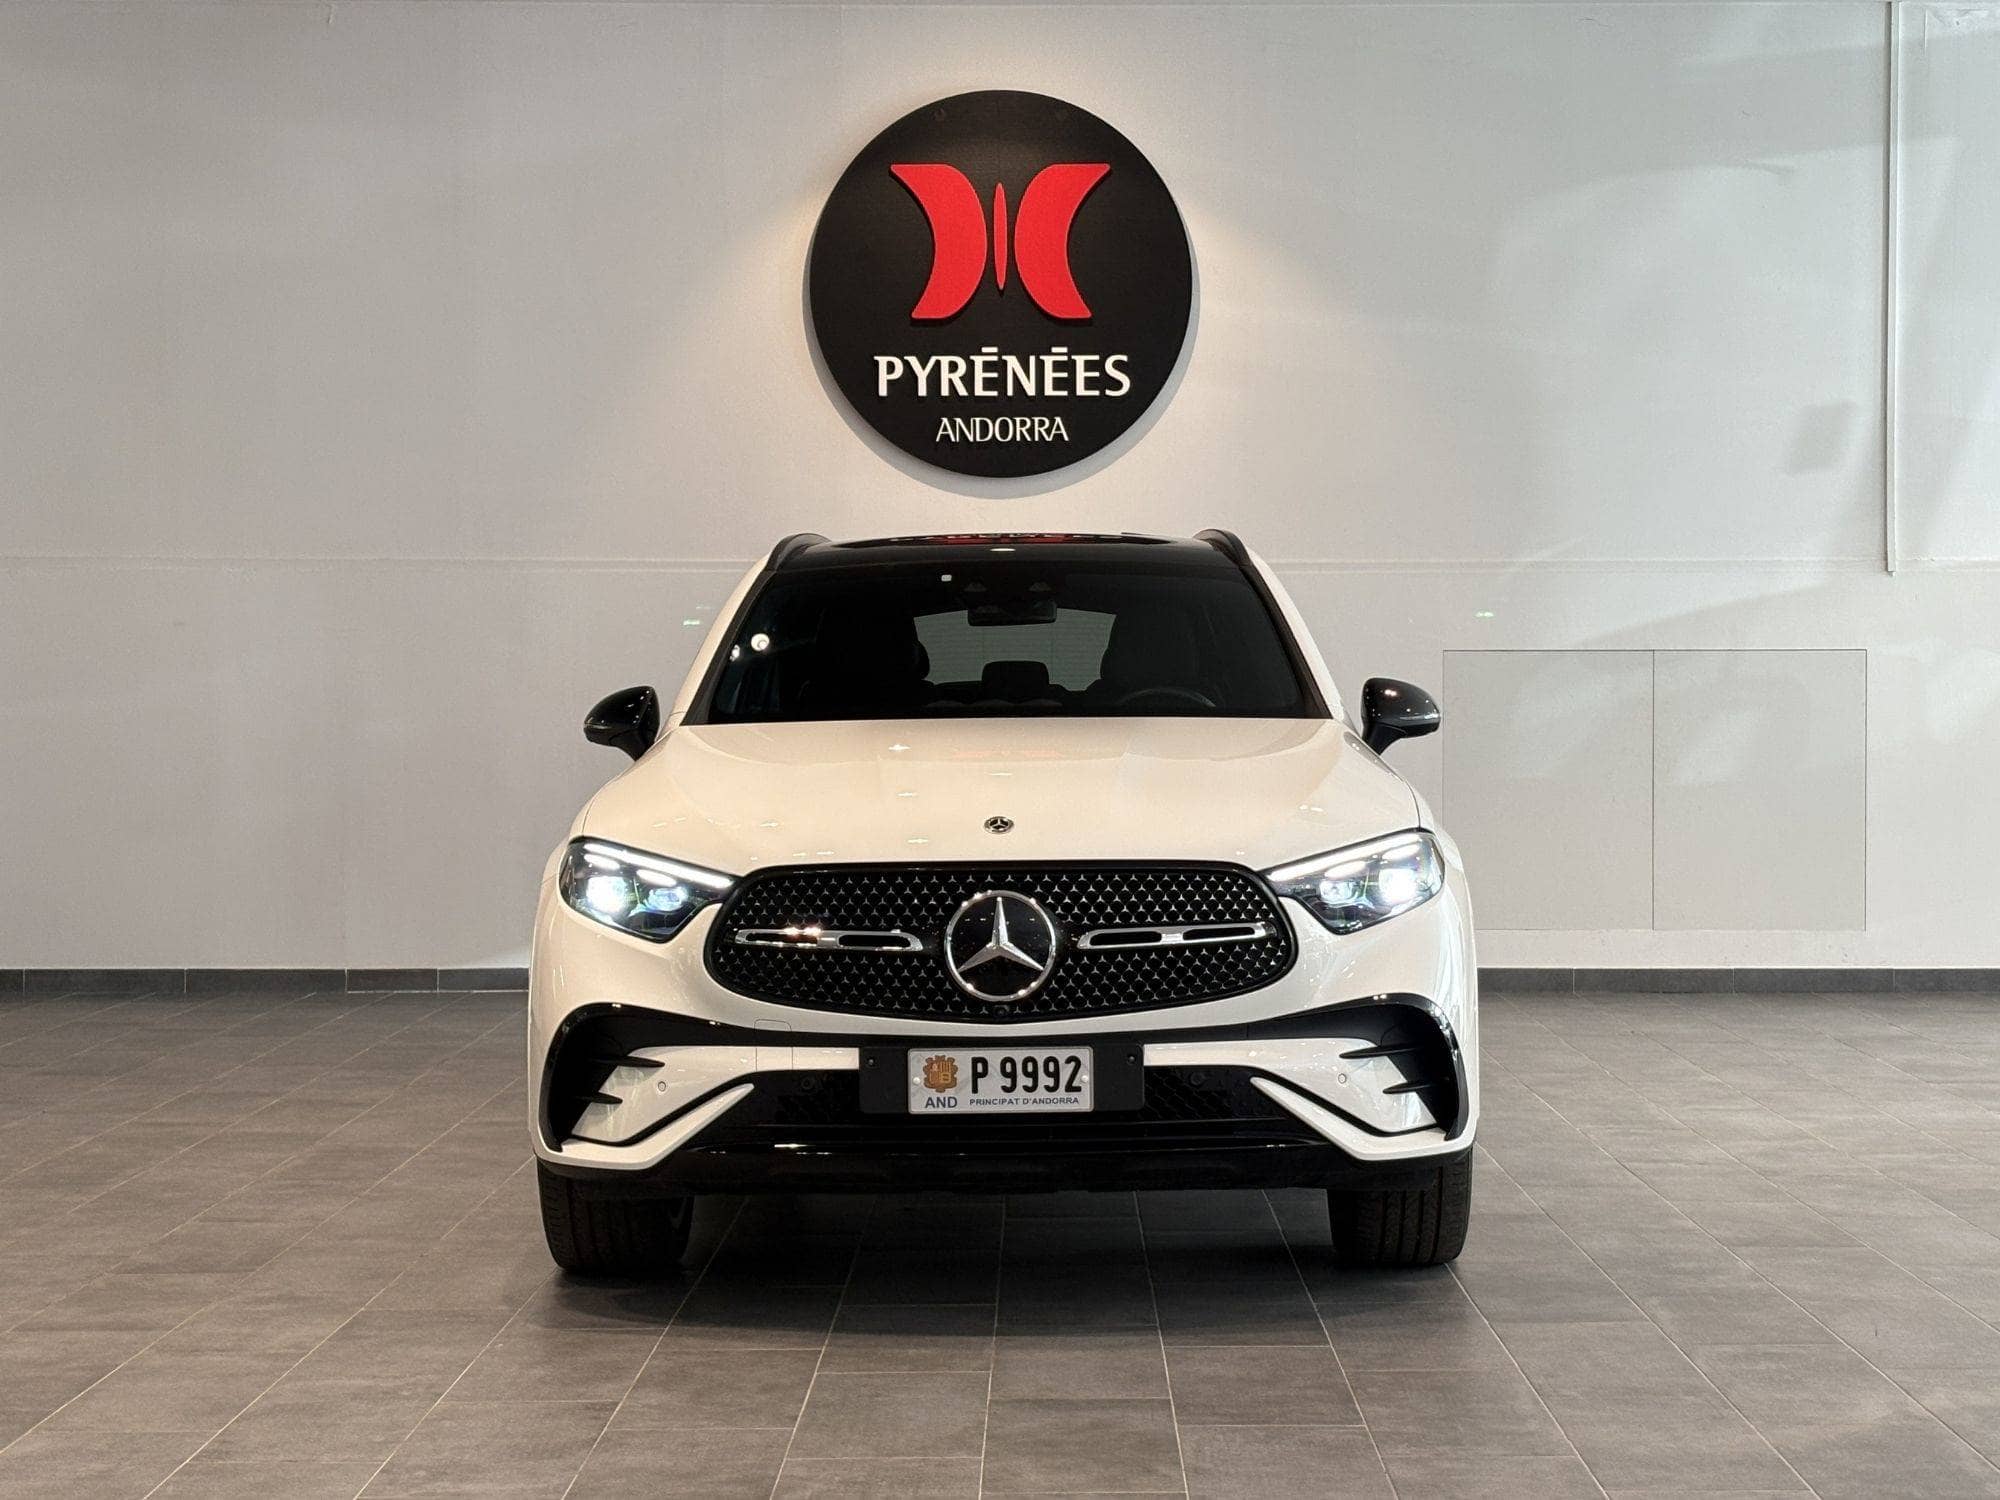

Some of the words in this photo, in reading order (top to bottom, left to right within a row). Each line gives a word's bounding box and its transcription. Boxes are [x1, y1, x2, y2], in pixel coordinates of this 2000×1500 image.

[936, 416, 1069, 442] ANDORRA
[970, 1056, 989, 1094] P
[1000, 1055, 1082, 1093] 9992
[924, 1096, 958, 1109] AND
[969, 1097, 1020, 1106] PRINCIPAT
[1022, 1096, 1080, 1106] D'ANDORRA
